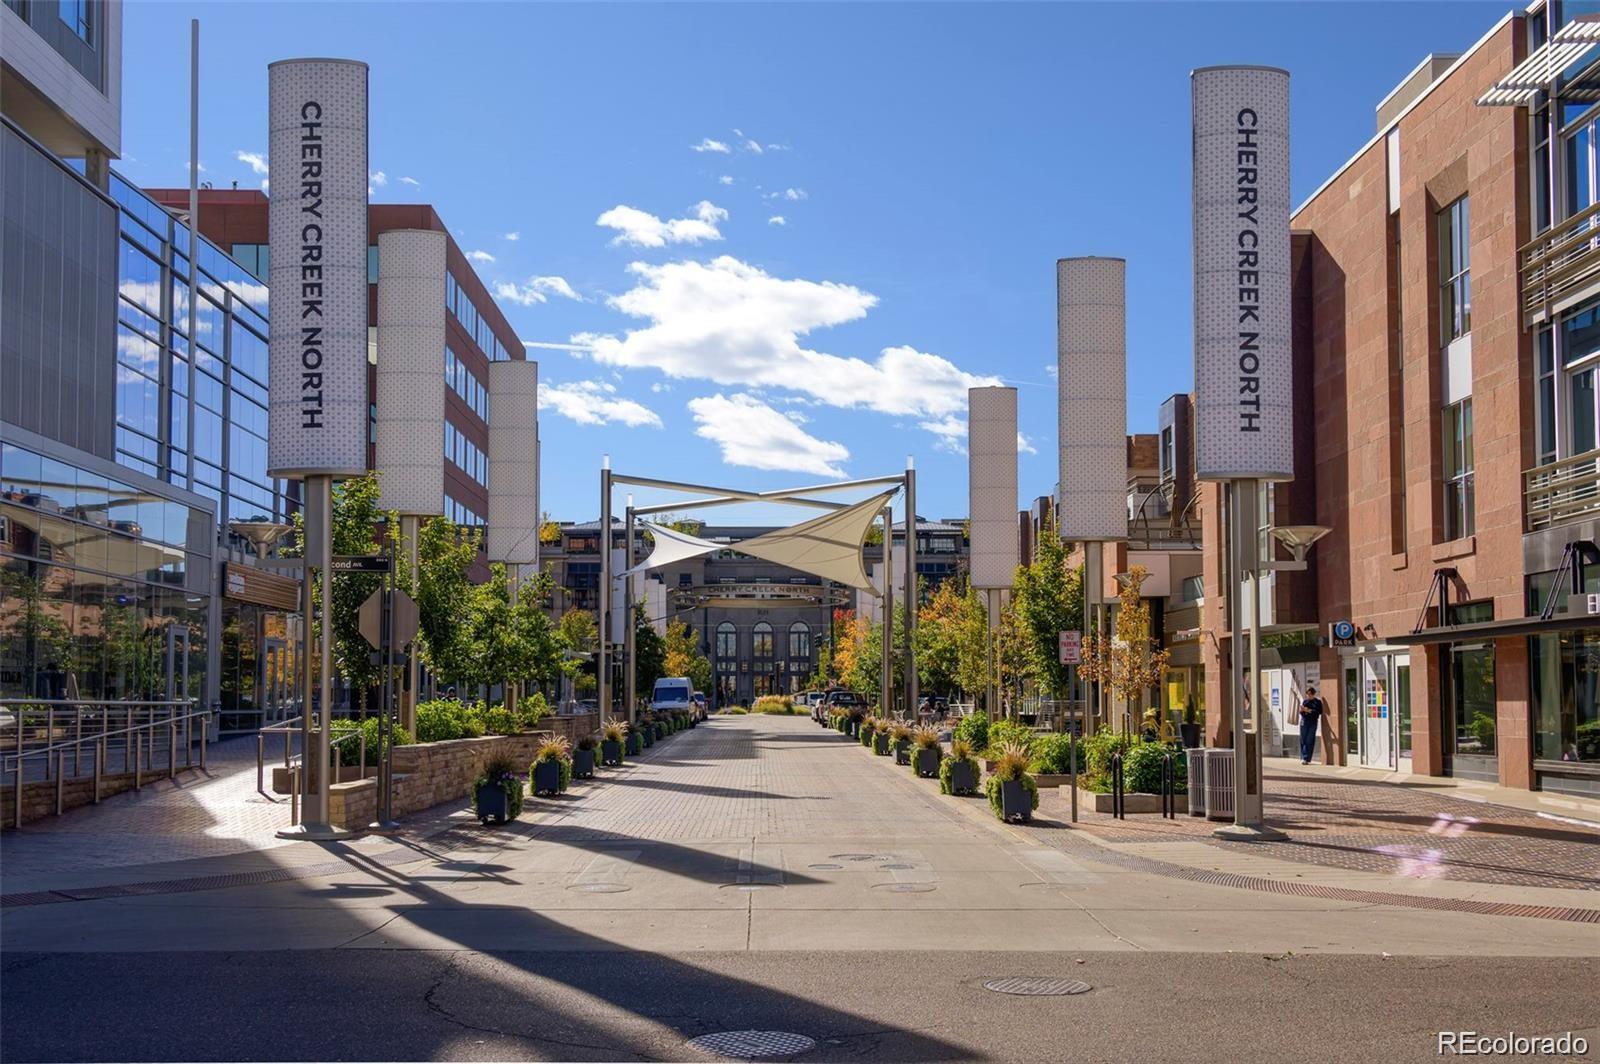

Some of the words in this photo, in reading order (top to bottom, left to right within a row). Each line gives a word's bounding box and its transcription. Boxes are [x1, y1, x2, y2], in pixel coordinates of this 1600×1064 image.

[301, 101, 322, 218] CHERRY
[1237, 108, 1259, 225] CHERRY
[302, 223, 323, 319] CREEK
[1238, 229, 1260, 324] CREEK
[302, 327, 323, 428] NORTH
[1239, 332, 1261, 432] NORTH
